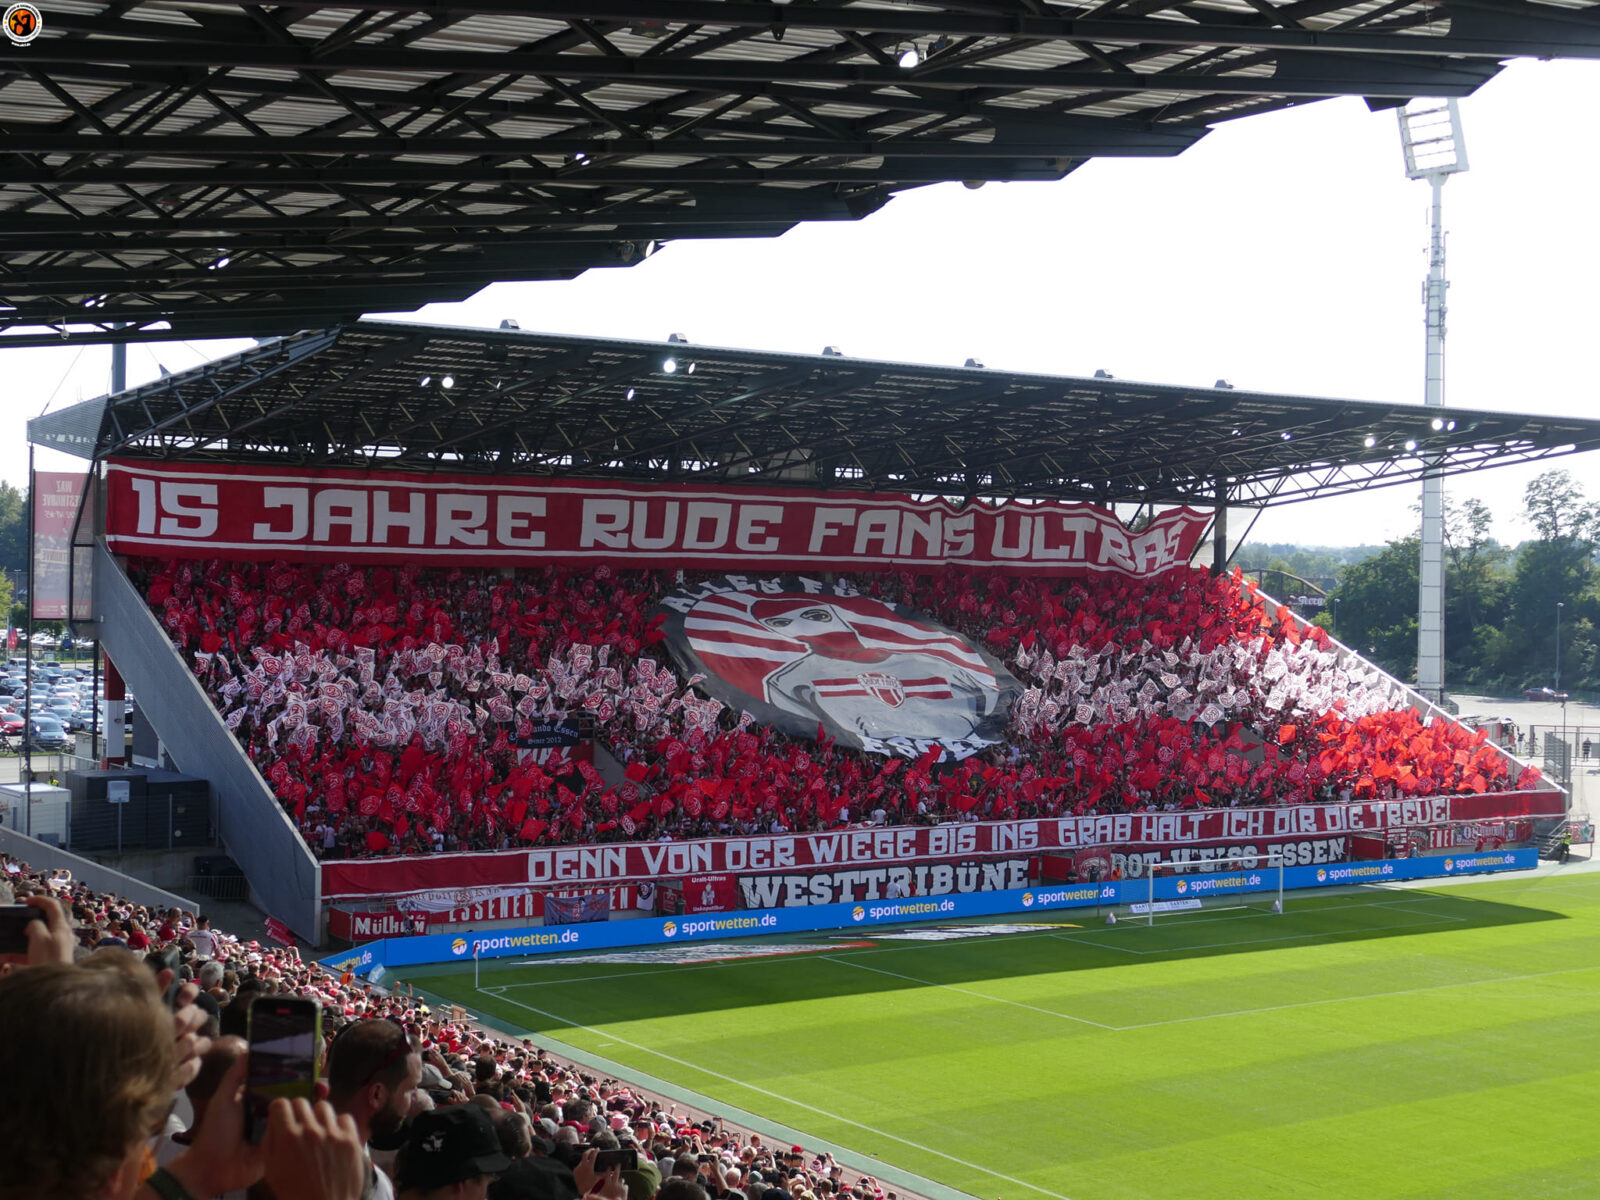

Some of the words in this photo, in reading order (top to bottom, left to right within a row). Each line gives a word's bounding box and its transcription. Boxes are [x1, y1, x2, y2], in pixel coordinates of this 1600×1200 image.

[131, 477, 219, 539] 15
[252, 486, 547, 549] JAHRE
[579, 498, 784, 553] RUDE
[807, 507, 975, 557] FANS
[990, 514, 1189, 574] ULTRAS
[528, 846, 627, 883] DENN
[641, 842, 713, 876] VON
[725, 837, 795, 871] DER
[808, 829, 917, 863] WIEGE
[928, 826, 977, 855] BIS
[991, 822, 1039, 851] INS
[1057, 816, 1132, 847] GRAB
[1222, 810, 1264, 837] ICH
[1274, 807, 1316, 835] DIR
[1325, 805, 1364, 831] DIE
[1267, 837, 1347, 868] ESSEN
[1456, 853, 1516, 869] sportwetten.de
[1328, 864, 1394, 880] sportwetten.de
[738, 859, 1030, 910] WESTTRIBÜNE
[1190, 873, 1262, 893] sportwetten.de
[1037, 886, 1116, 906] sportwetten.de
[869, 899, 956, 919] sportwetten.de
[682, 914, 777, 936] sportwetten.de
